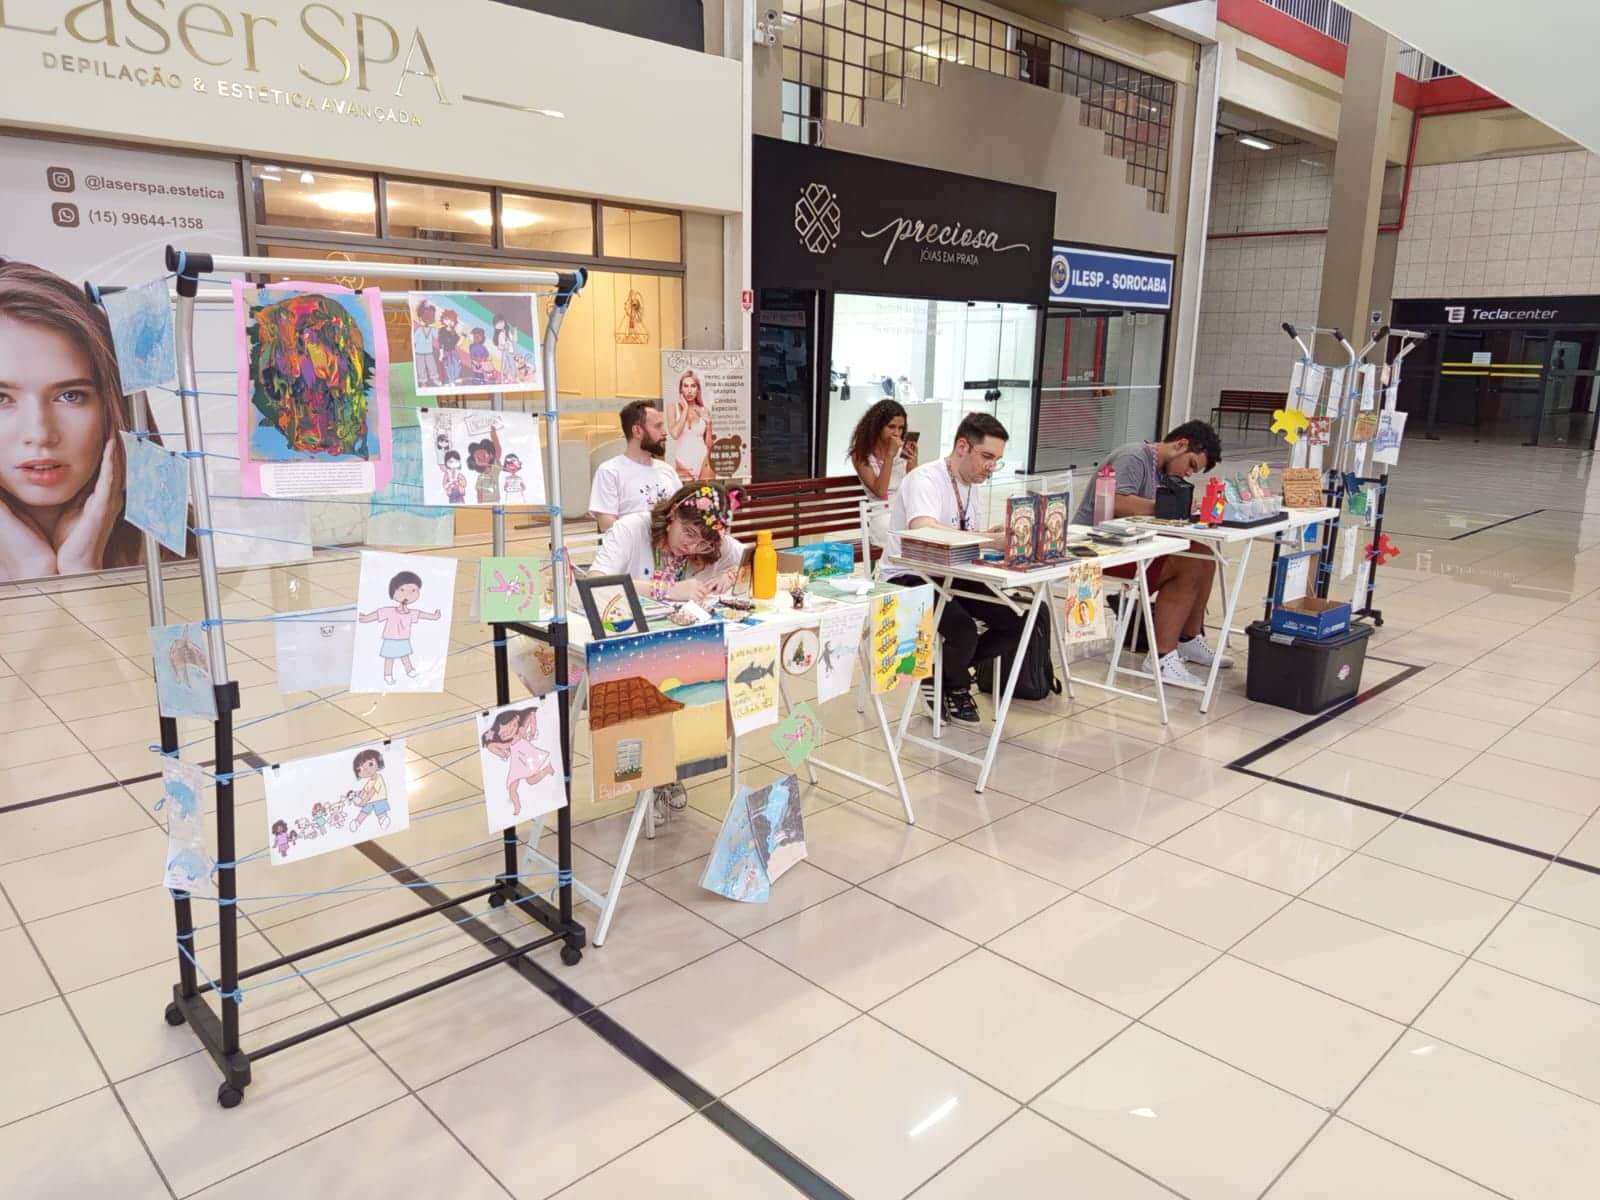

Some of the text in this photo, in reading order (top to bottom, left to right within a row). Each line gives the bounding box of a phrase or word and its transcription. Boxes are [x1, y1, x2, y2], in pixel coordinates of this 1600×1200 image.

[298, 3, 452, 105] SPA
[42, 51, 182, 88] DEPILAÇÃO
[192, 76, 208, 94] &
[321, 96, 424, 127] AVANÇADA
[85, 175, 225, 200] @laserspa.estetica
[88, 209, 203, 230] (15) 99644-1358
[861, 217, 1031, 265] preciosa
[943, 251, 956, 263] EM
[957, 252, 979, 265] PRATA
[1071, 269, 1104, 287] ILESP
[1112, 273, 1167, 293] SOROCABA
[1472, 308, 1558, 320] Teclacenter
